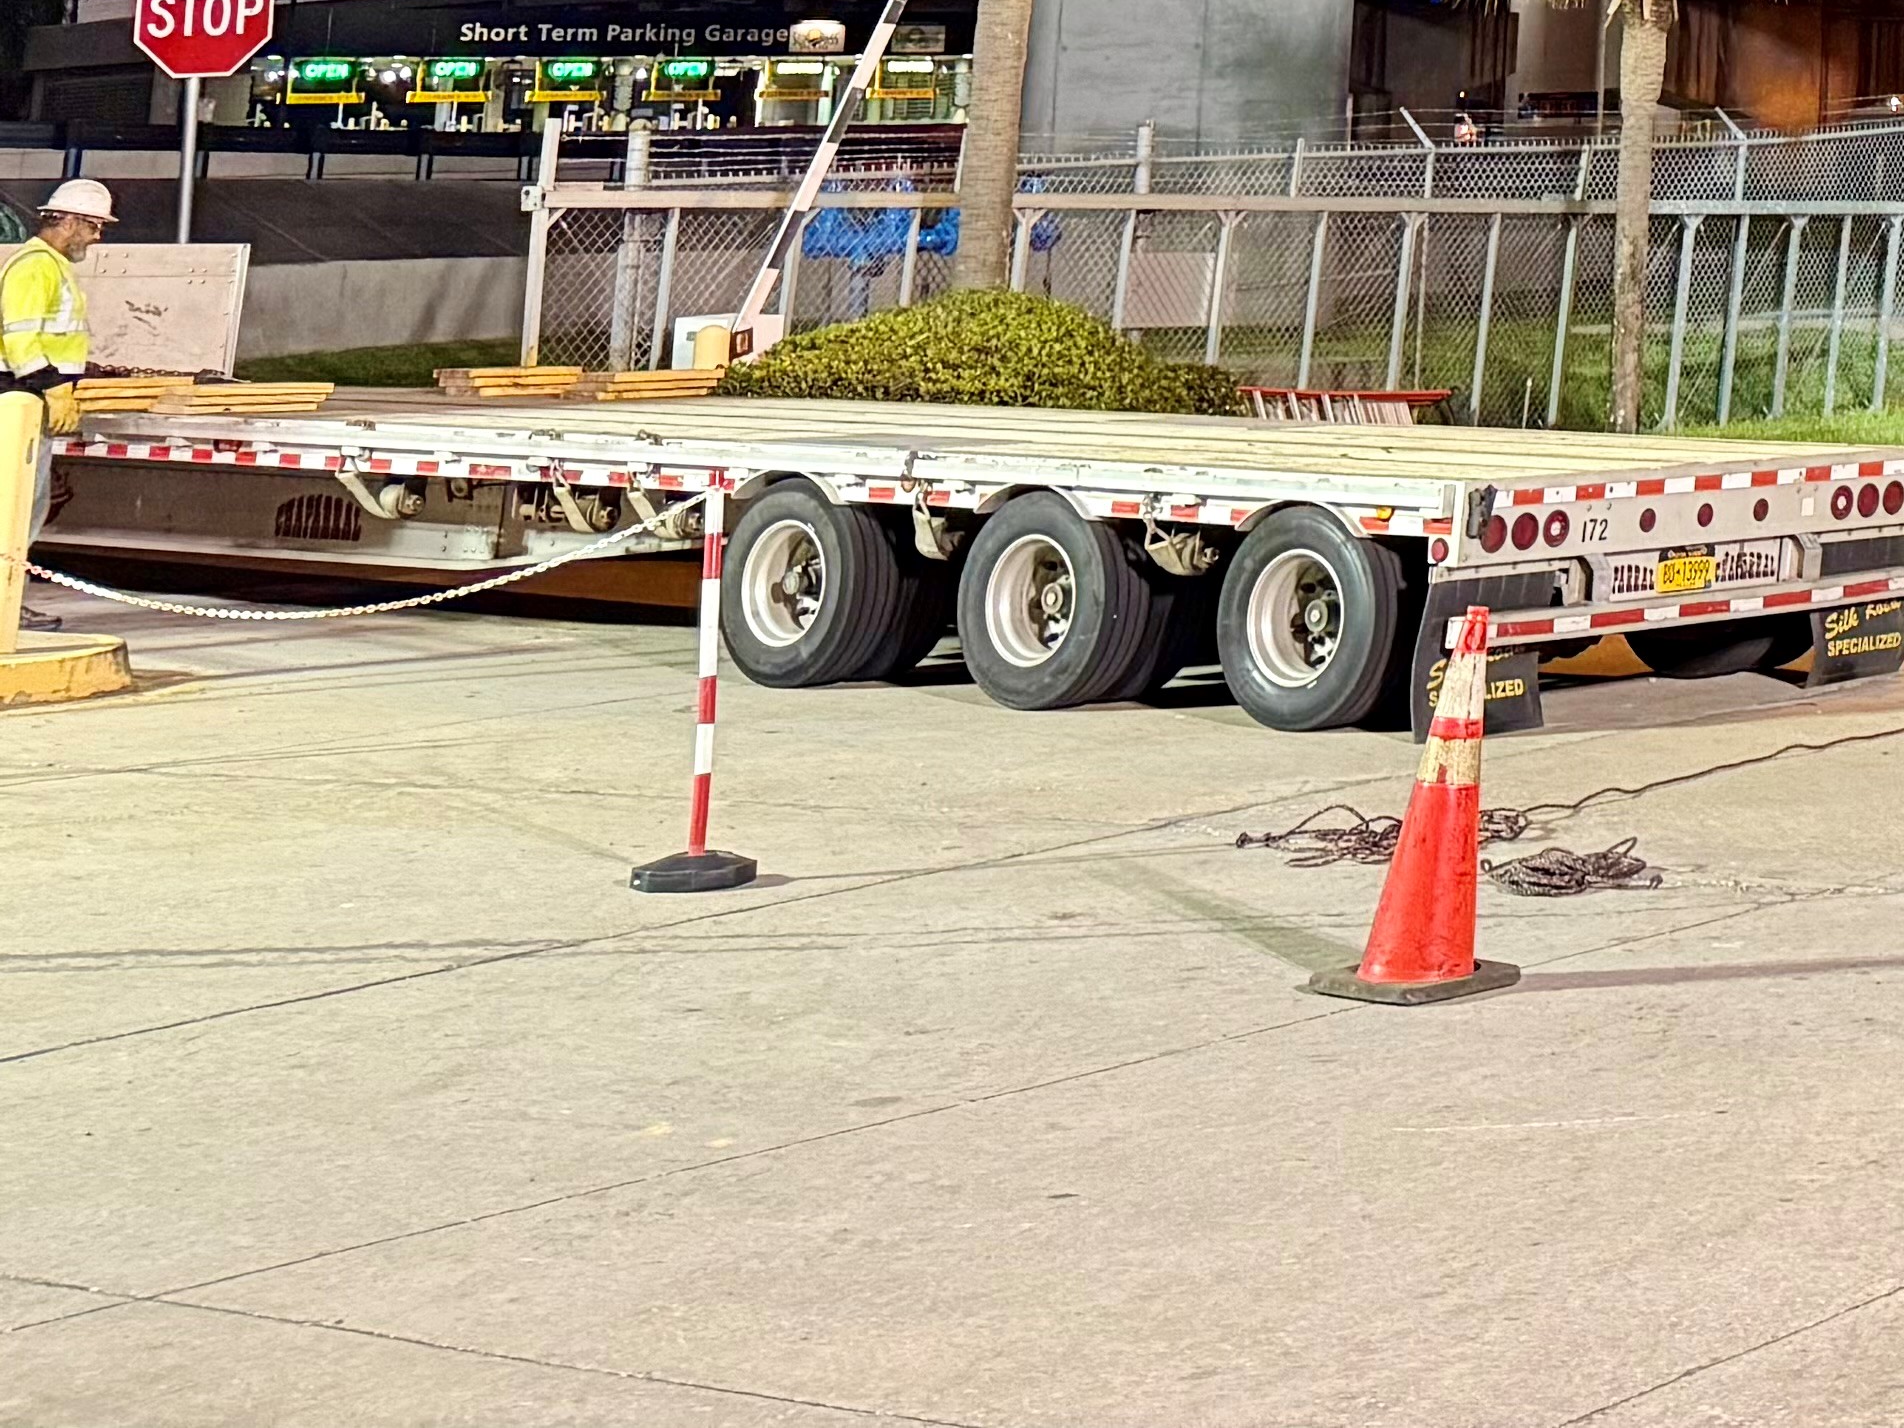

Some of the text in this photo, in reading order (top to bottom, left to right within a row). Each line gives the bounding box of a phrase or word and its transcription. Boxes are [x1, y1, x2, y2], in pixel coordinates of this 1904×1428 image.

[460, 22, 529, 42] Short
[538, 23, 598, 42] Term
[606, 23, 696, 47] Parking
[705, 24, 788, 47] Garage
[1581, 518, 1609, 543] 172
[1824, 606, 1860, 640] Silk
[1827, 631, 1902, 657] SPECIALIZED
